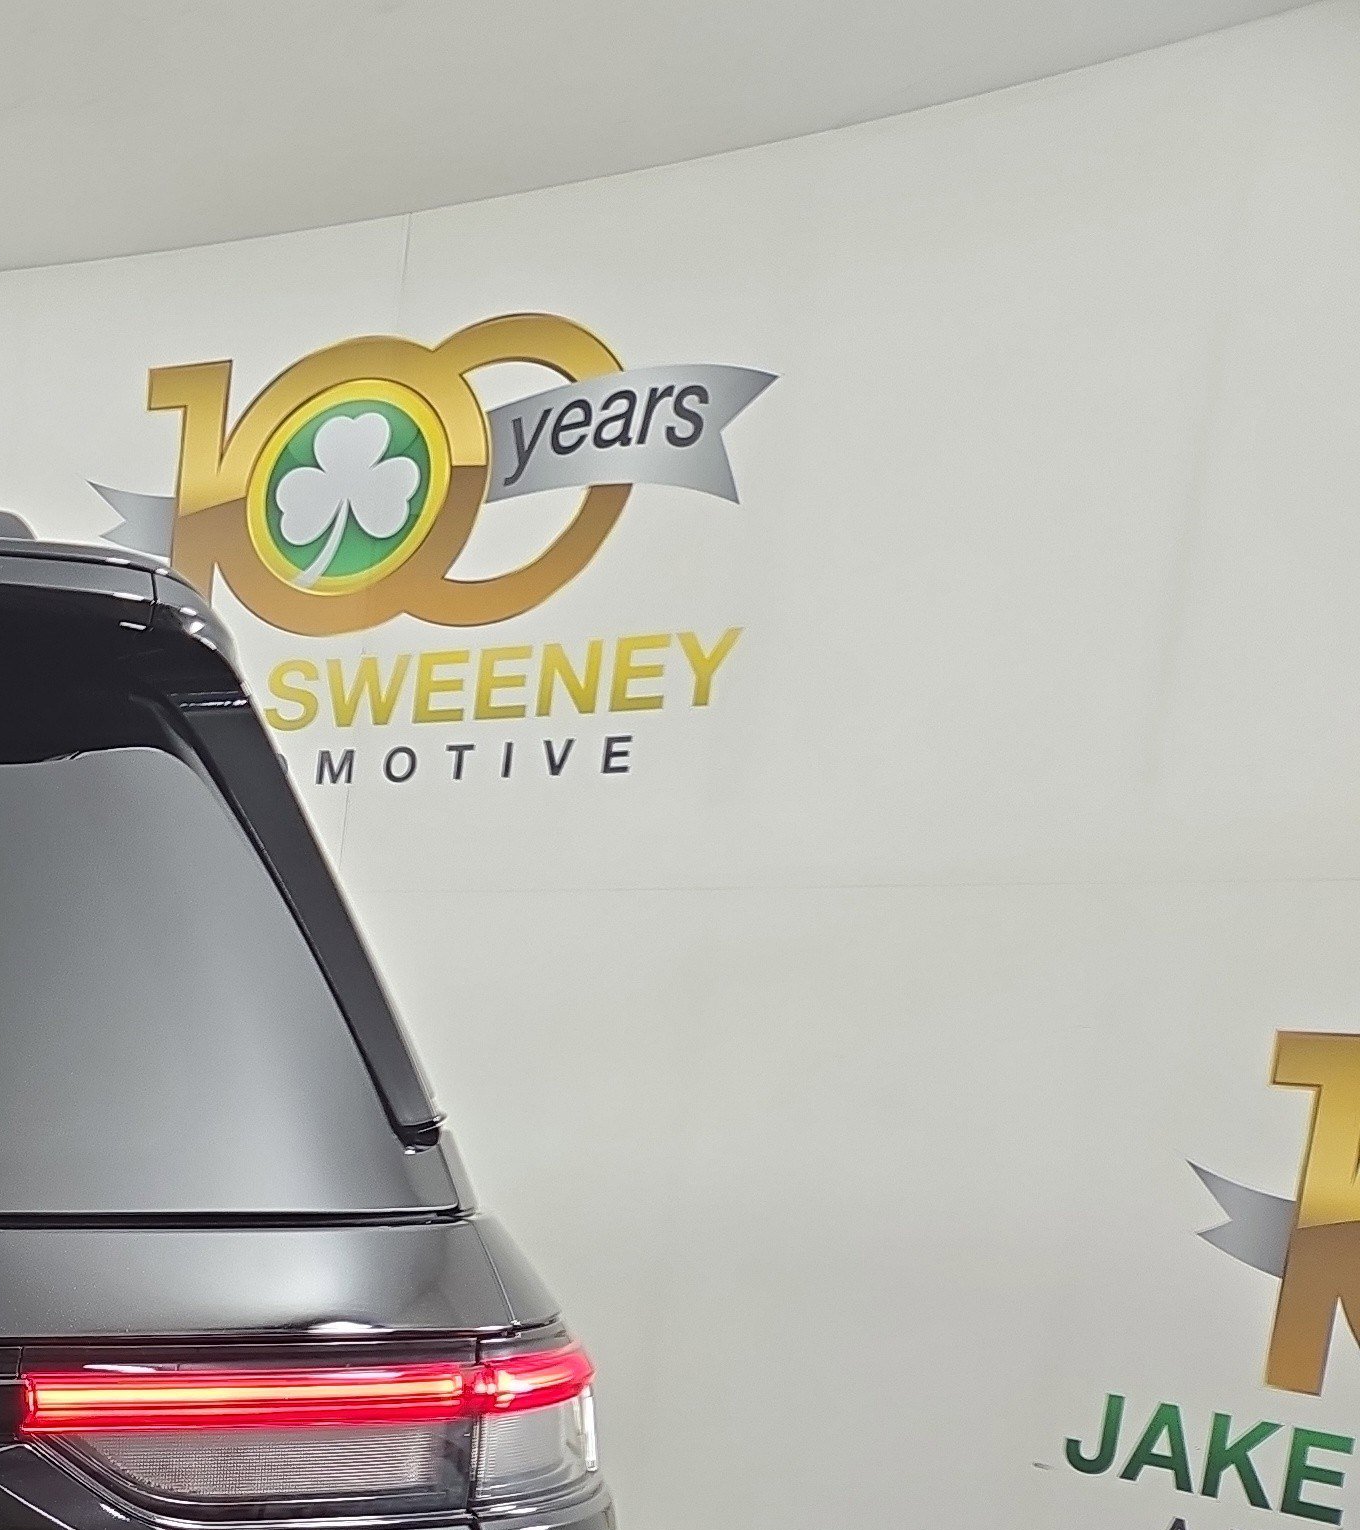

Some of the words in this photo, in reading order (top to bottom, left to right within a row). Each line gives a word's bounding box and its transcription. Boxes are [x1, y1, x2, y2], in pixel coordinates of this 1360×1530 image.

[503, 382, 710, 487] years
[264, 627, 744, 732] SWEENEY
[279, 735, 634, 786] MOTIVE
[1065, 1393, 1355, 1526] JAKE
